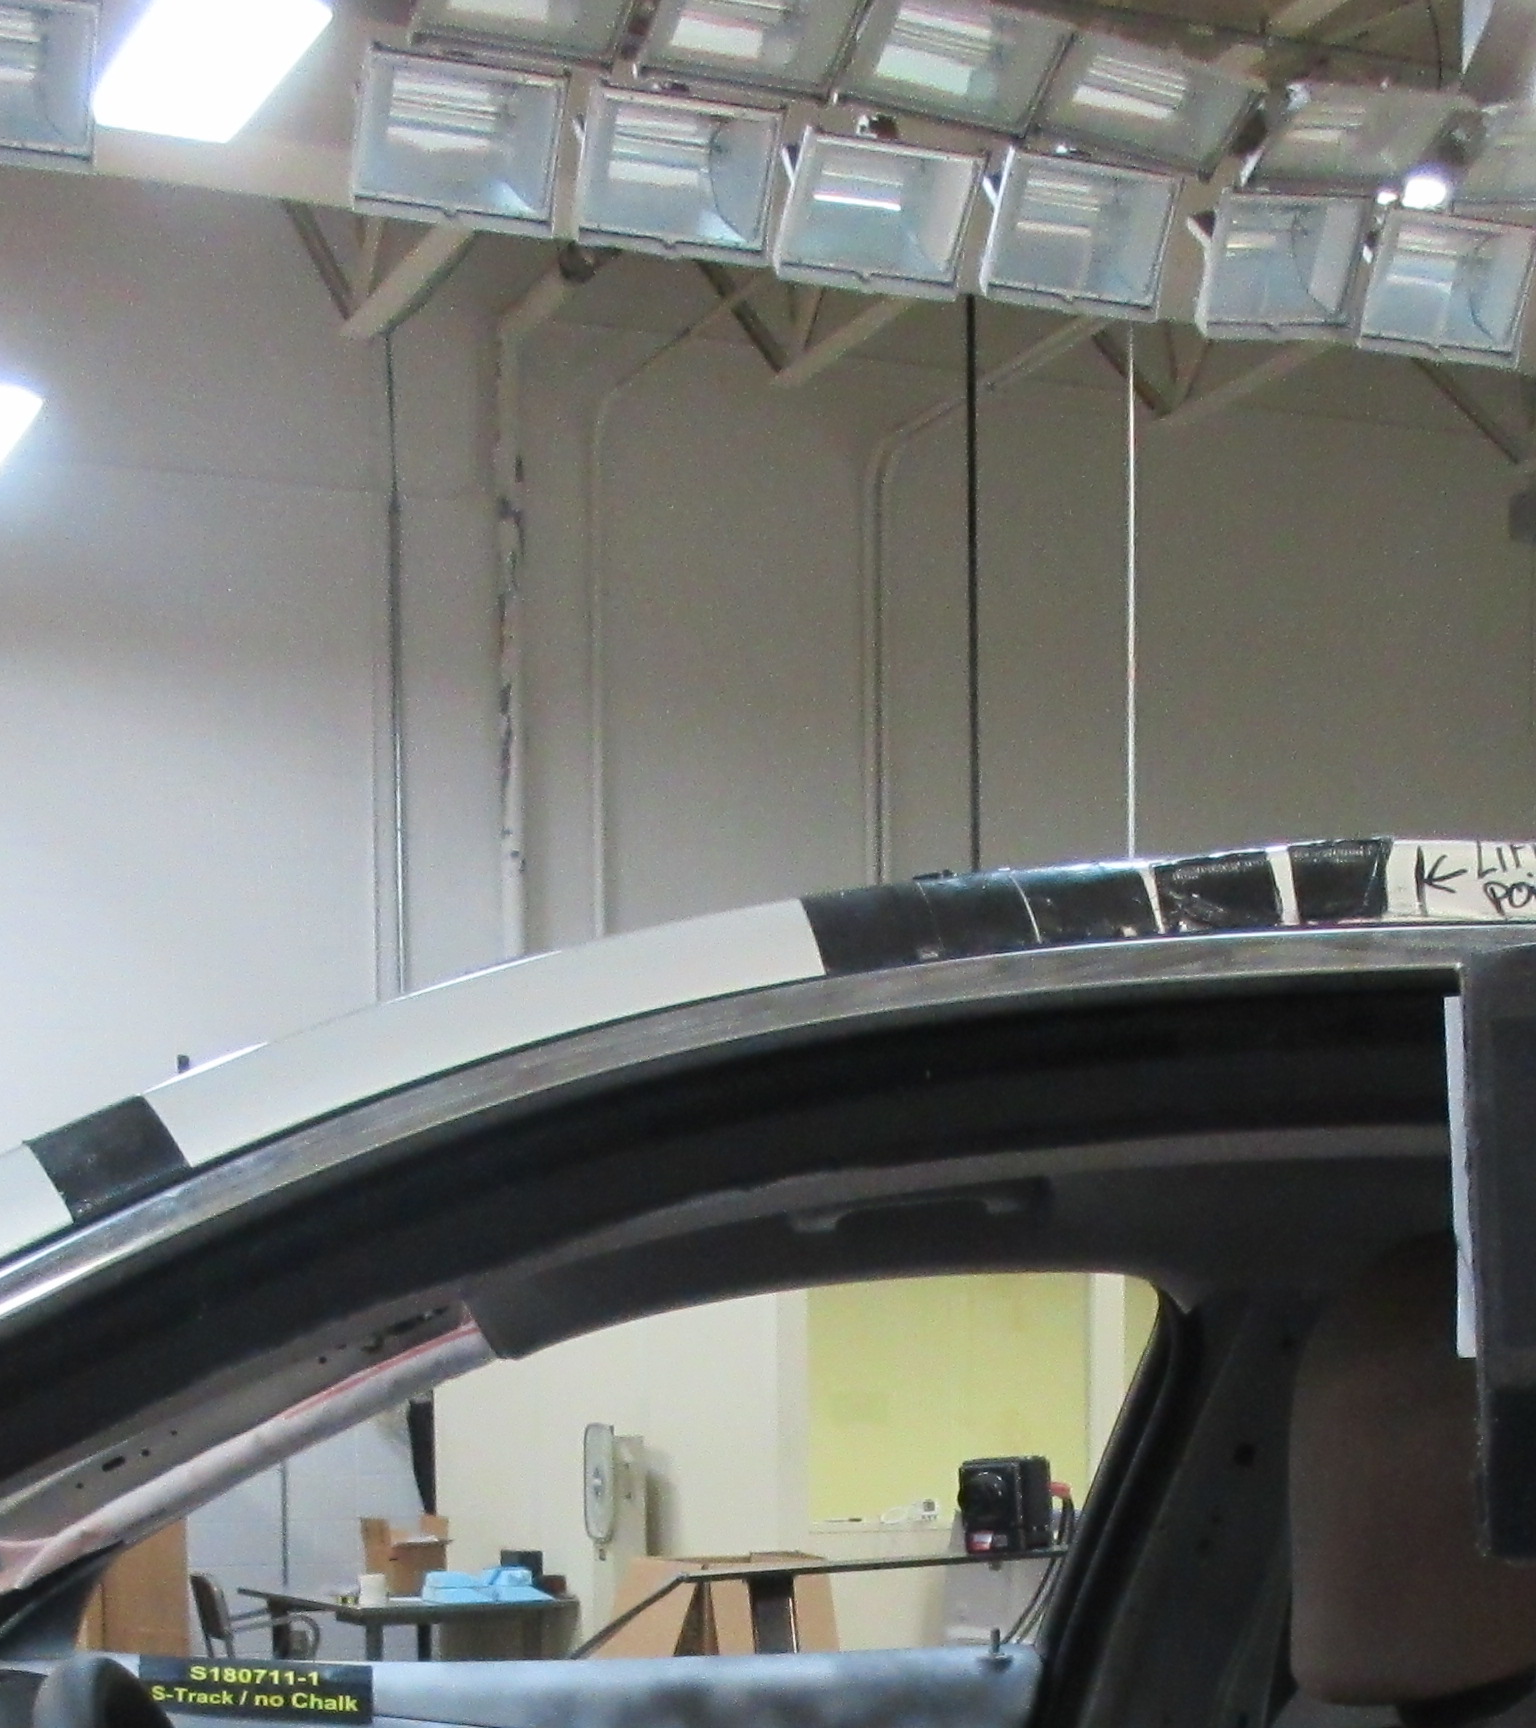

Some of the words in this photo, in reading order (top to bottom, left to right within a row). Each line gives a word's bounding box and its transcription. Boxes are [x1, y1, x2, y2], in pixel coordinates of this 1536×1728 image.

[190, 1665, 321, 1686] S180711-1
[150, 1684, 235, 1706] S-Track
[239, 1690, 249, 1706] /
[253, 1694, 285, 1708] no
[291, 1691, 360, 1713] Chalk
